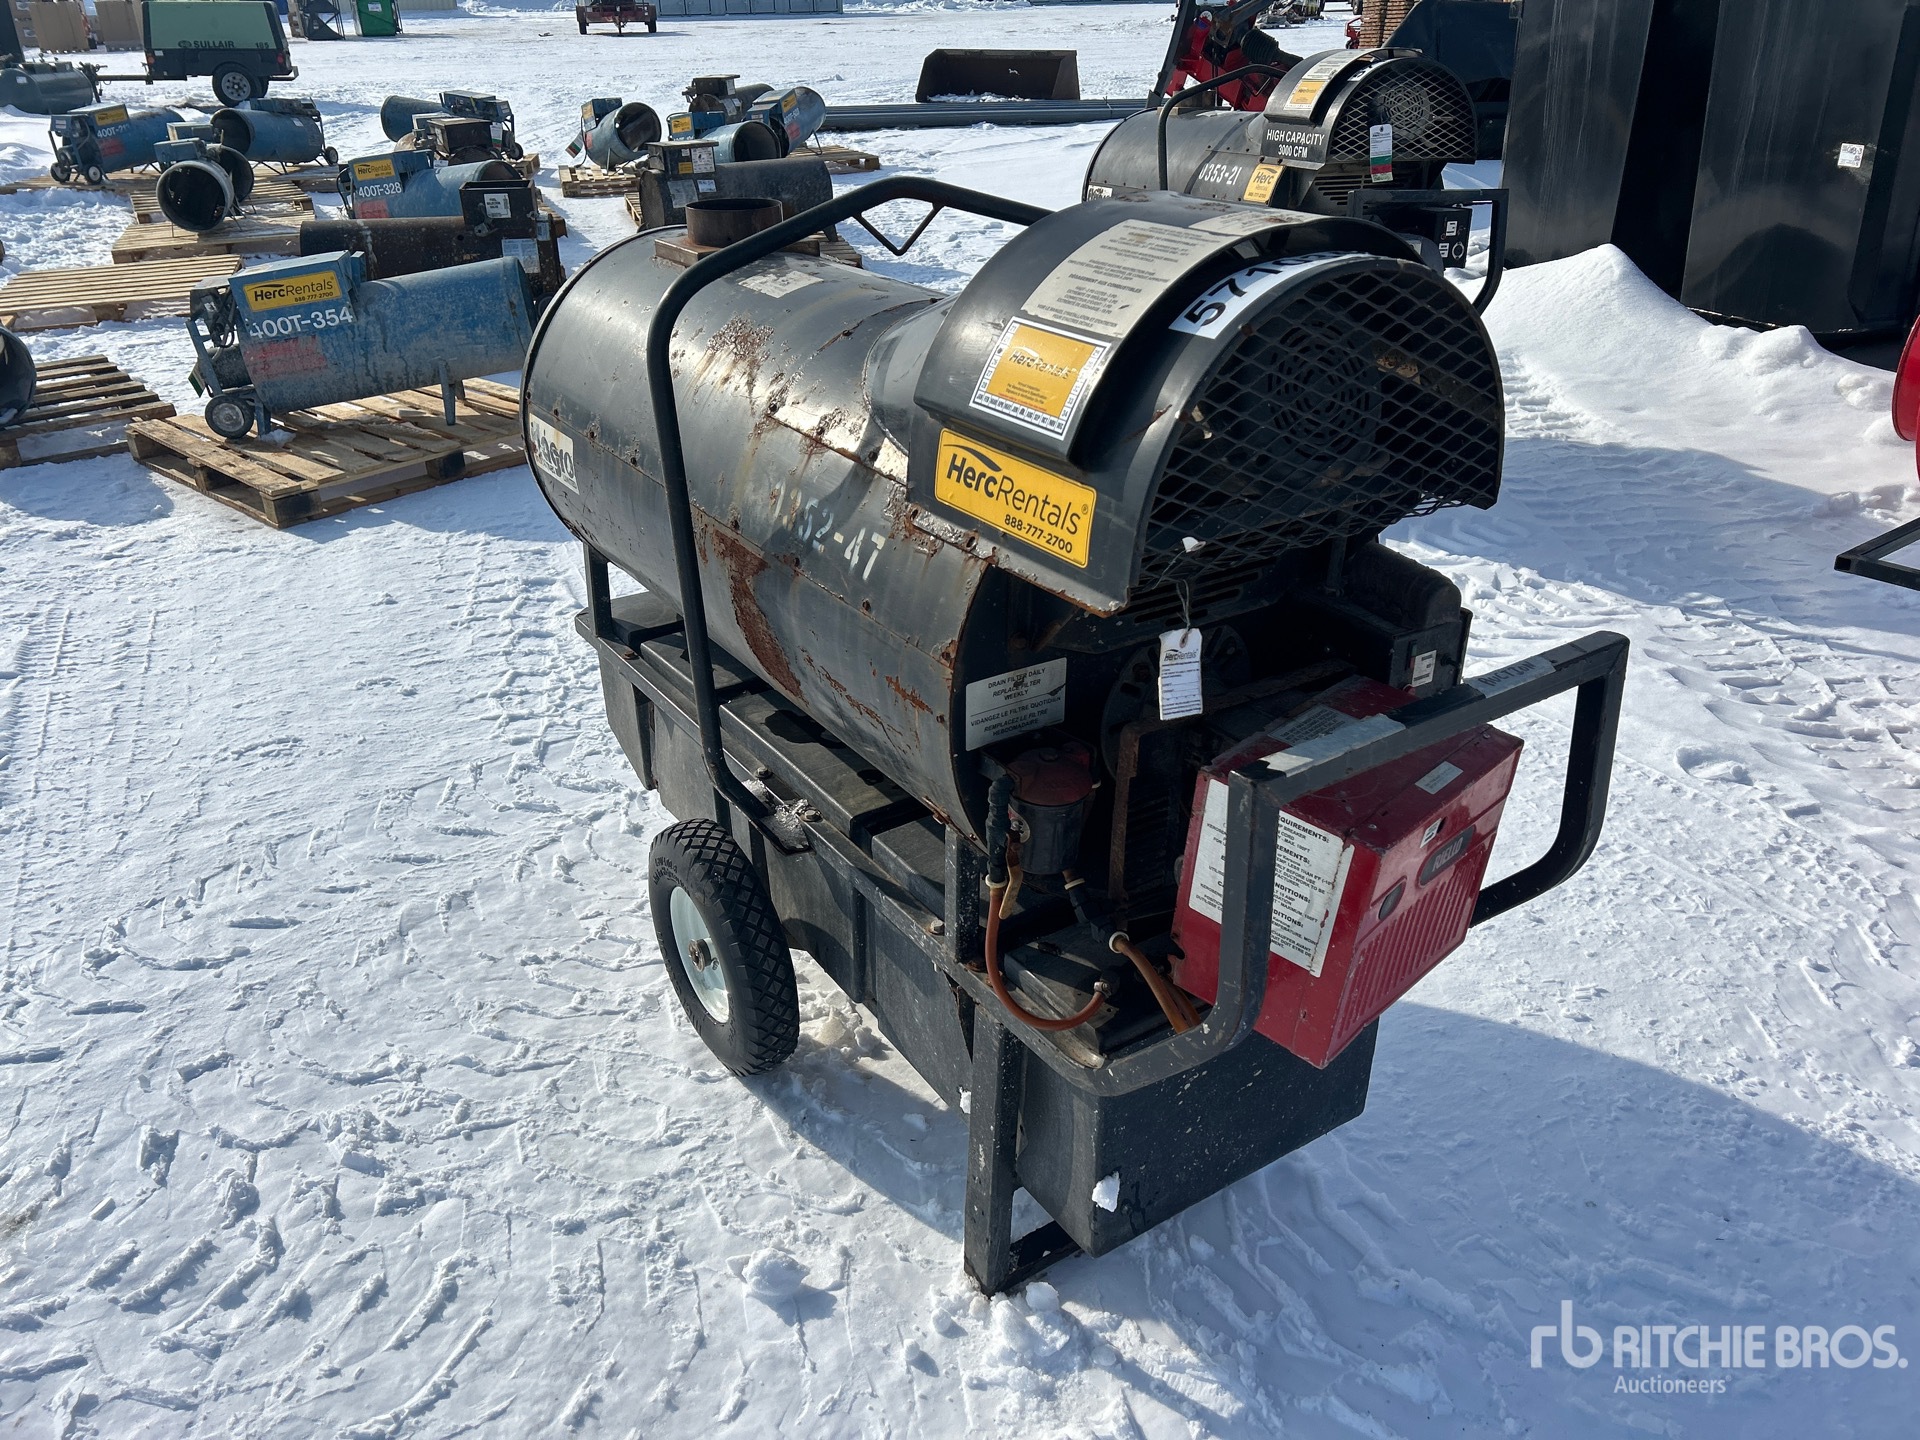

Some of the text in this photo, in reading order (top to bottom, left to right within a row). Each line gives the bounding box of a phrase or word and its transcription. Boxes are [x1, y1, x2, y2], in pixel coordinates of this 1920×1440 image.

[194, 40, 235, 48] SULLAIR
[1266, 129, 1325, 146] HIGH CAPACITY
[1278, 144, 1308, 158] 3000 CFM
[1253, 172, 1274, 184] Herc
[358, 182, 402, 198] 400T-328
[254, 279, 333, 302] HercRentals
[294, 292, 334, 303] 888-777-2700
[250, 306, 353, 339] 400T-354
[1008, 350, 1071, 380] HercRentals
[946, 453, 1081, 536] HercRentals
[1004, 514, 1073, 554] 888-777-2700
[988, 668, 1046, 688] DRAIN FILTER DAILY
[1478, 660, 1536, 687] AUCTION
[993, 679, 1041, 697] REPLACE FILTER
[1004, 690, 1028, 701] WEEKLY
[970, 714, 1000, 726] VIDANGEZ
[1010, 704, 1029, 715] FILTRE
[1030, 697, 1061, 709] QUOTIDIEN
[984, 718, 1019, 732] REMPLACEZ
[1029, 708, 1048, 718] FILTRE
[993, 719, 1038, 736] HEBDOMADAIRE
[1281, 832, 1294, 840] CORD
[1284, 826, 1306, 839] BREAKER
[1432, 836, 1463, 872] RIELLO
[1286, 867, 1305, 880] BEFORE
[1306, 876, 1316, 885] USE
[1287, 862, 1300, 871] LESS
[1300, 868, 1314, 878] THAN
[1283, 872, 1310, 887] DUCTWORK
[1280, 939, 1292, 947] DOIT
[1296, 942, 1311, 952] AVANT
